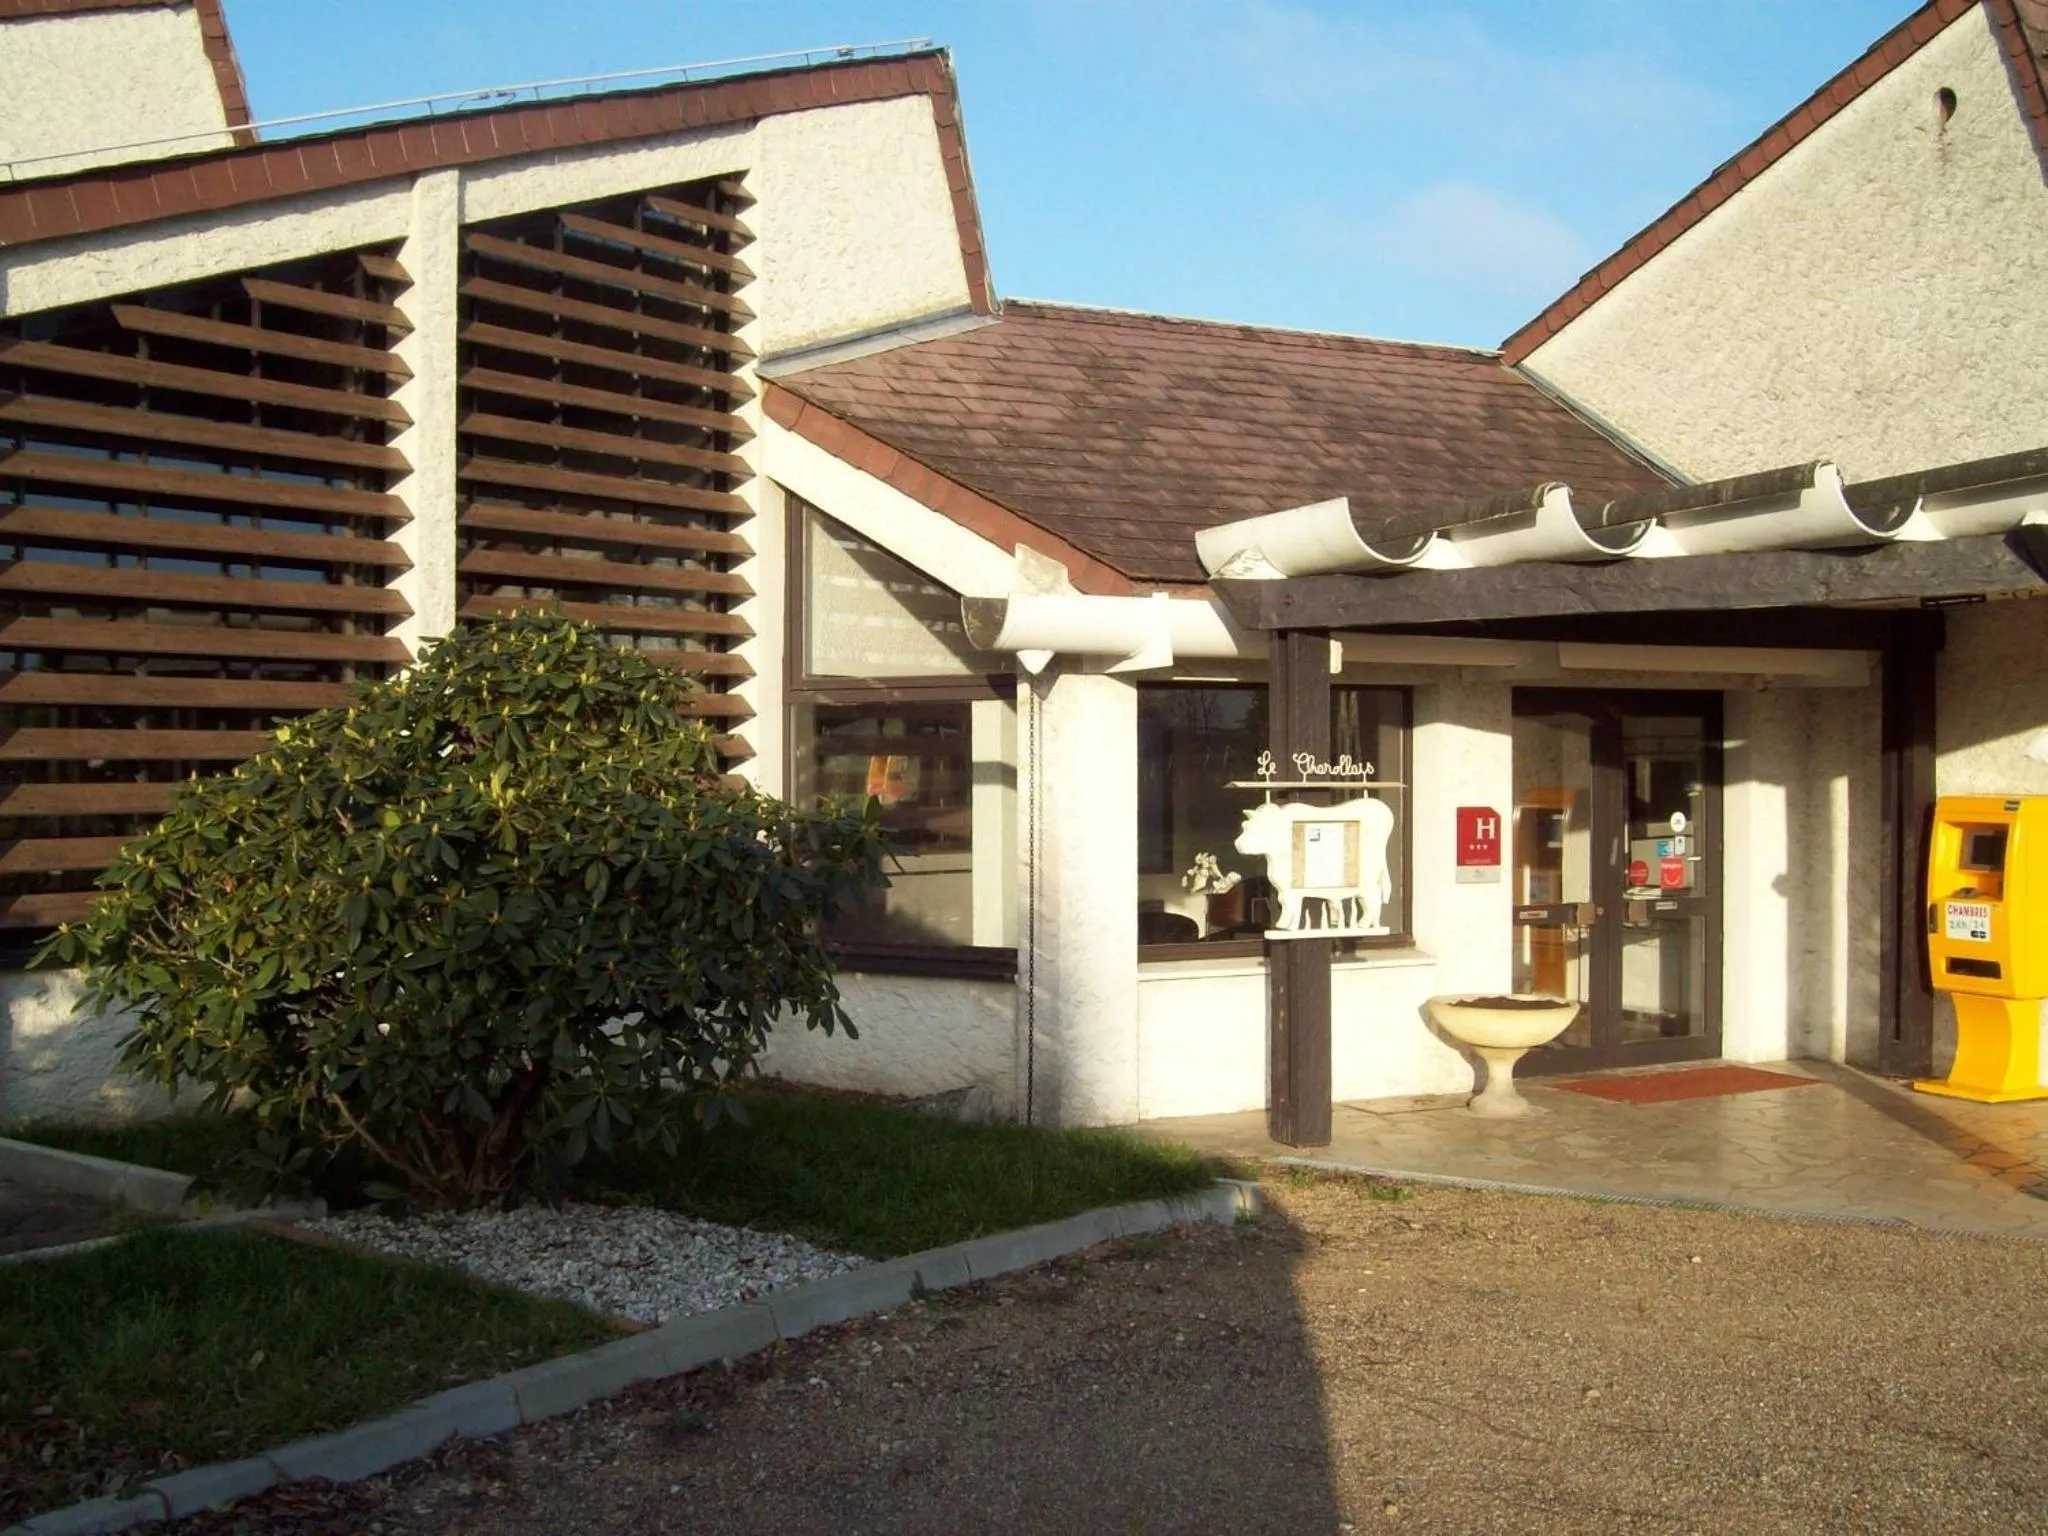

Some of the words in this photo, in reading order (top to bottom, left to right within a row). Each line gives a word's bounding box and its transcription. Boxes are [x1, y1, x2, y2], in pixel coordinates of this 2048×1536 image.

[1257, 750, 1277, 775] Le
[1476, 817, 1496, 839] H
[1948, 904, 1988, 918] CHAMBRES
